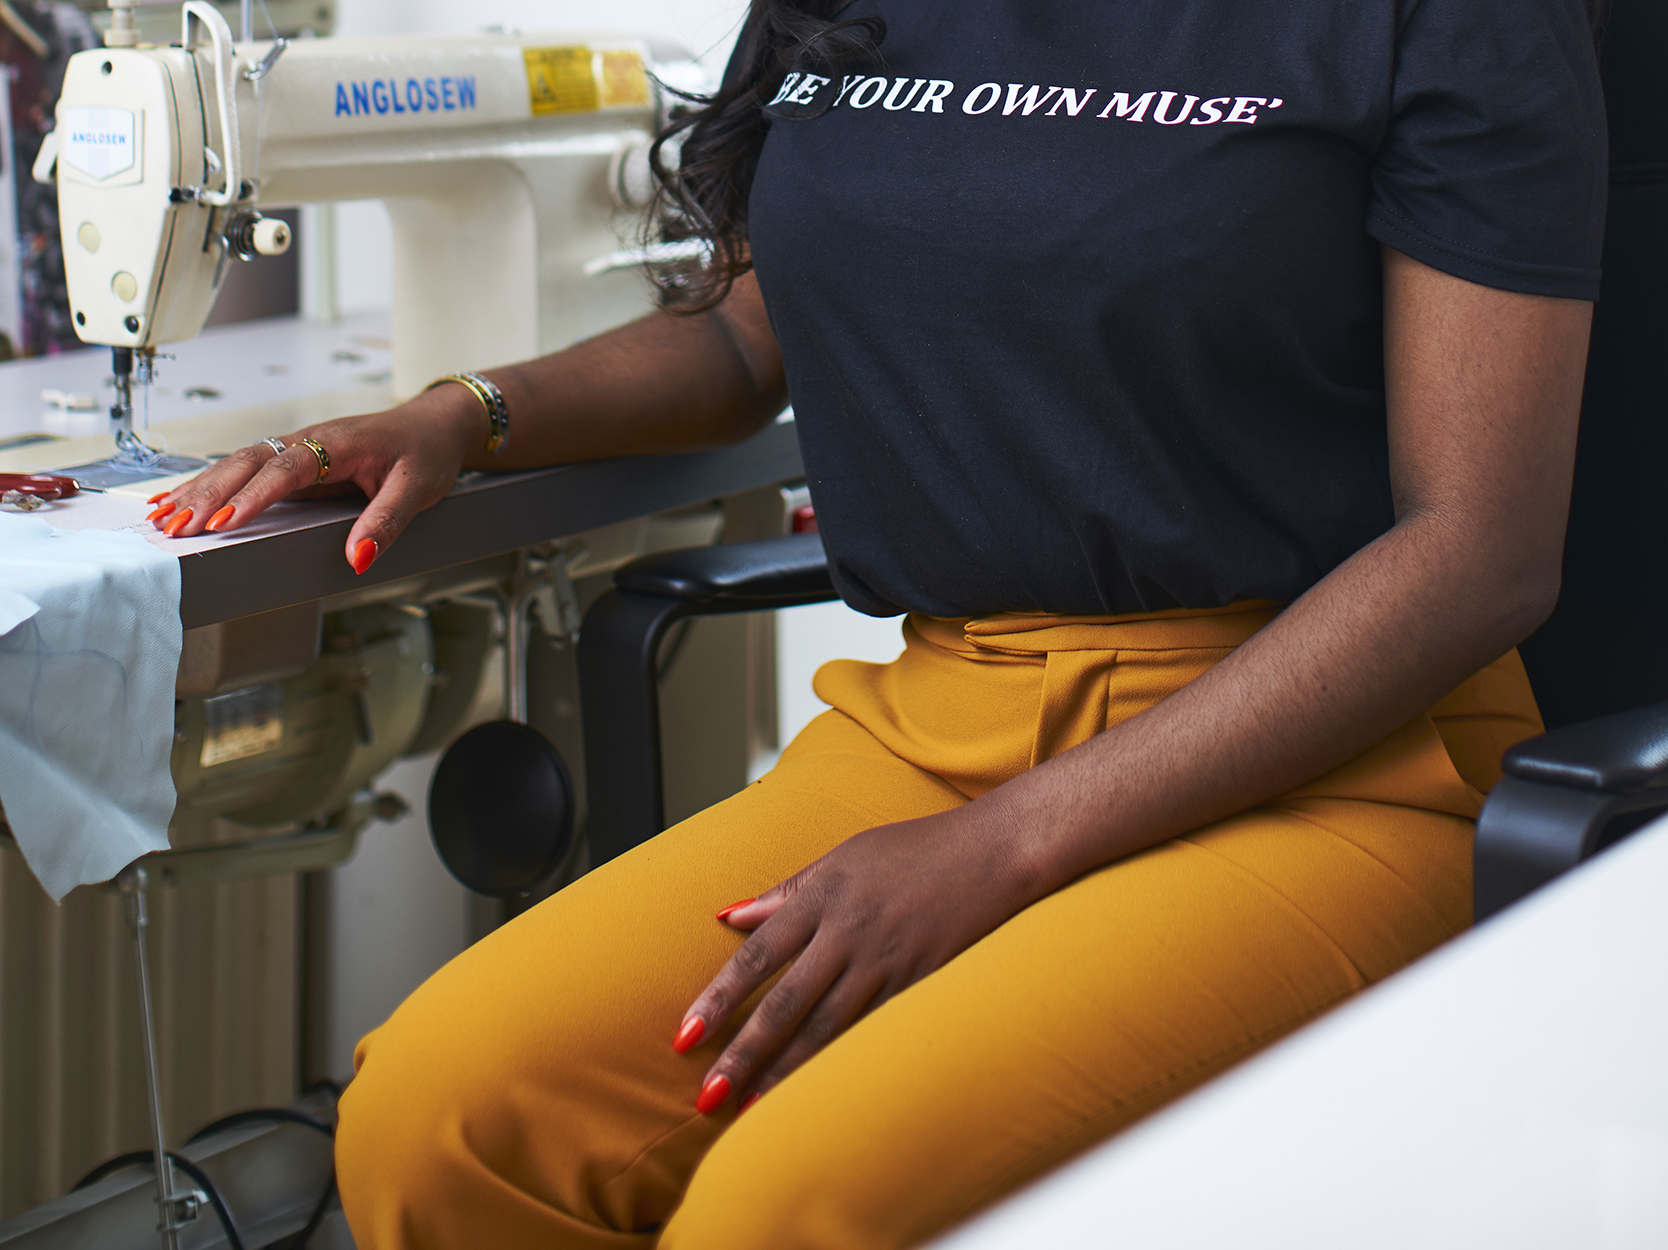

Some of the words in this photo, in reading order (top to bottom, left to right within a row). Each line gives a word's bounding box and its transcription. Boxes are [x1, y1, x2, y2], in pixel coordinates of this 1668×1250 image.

[335, 75, 477, 117] ANGLOSEW
[833, 74, 954, 114] YOUR
[961, 82, 1098, 117] OWN
[72, 132, 127, 146] ANGLOSEW
